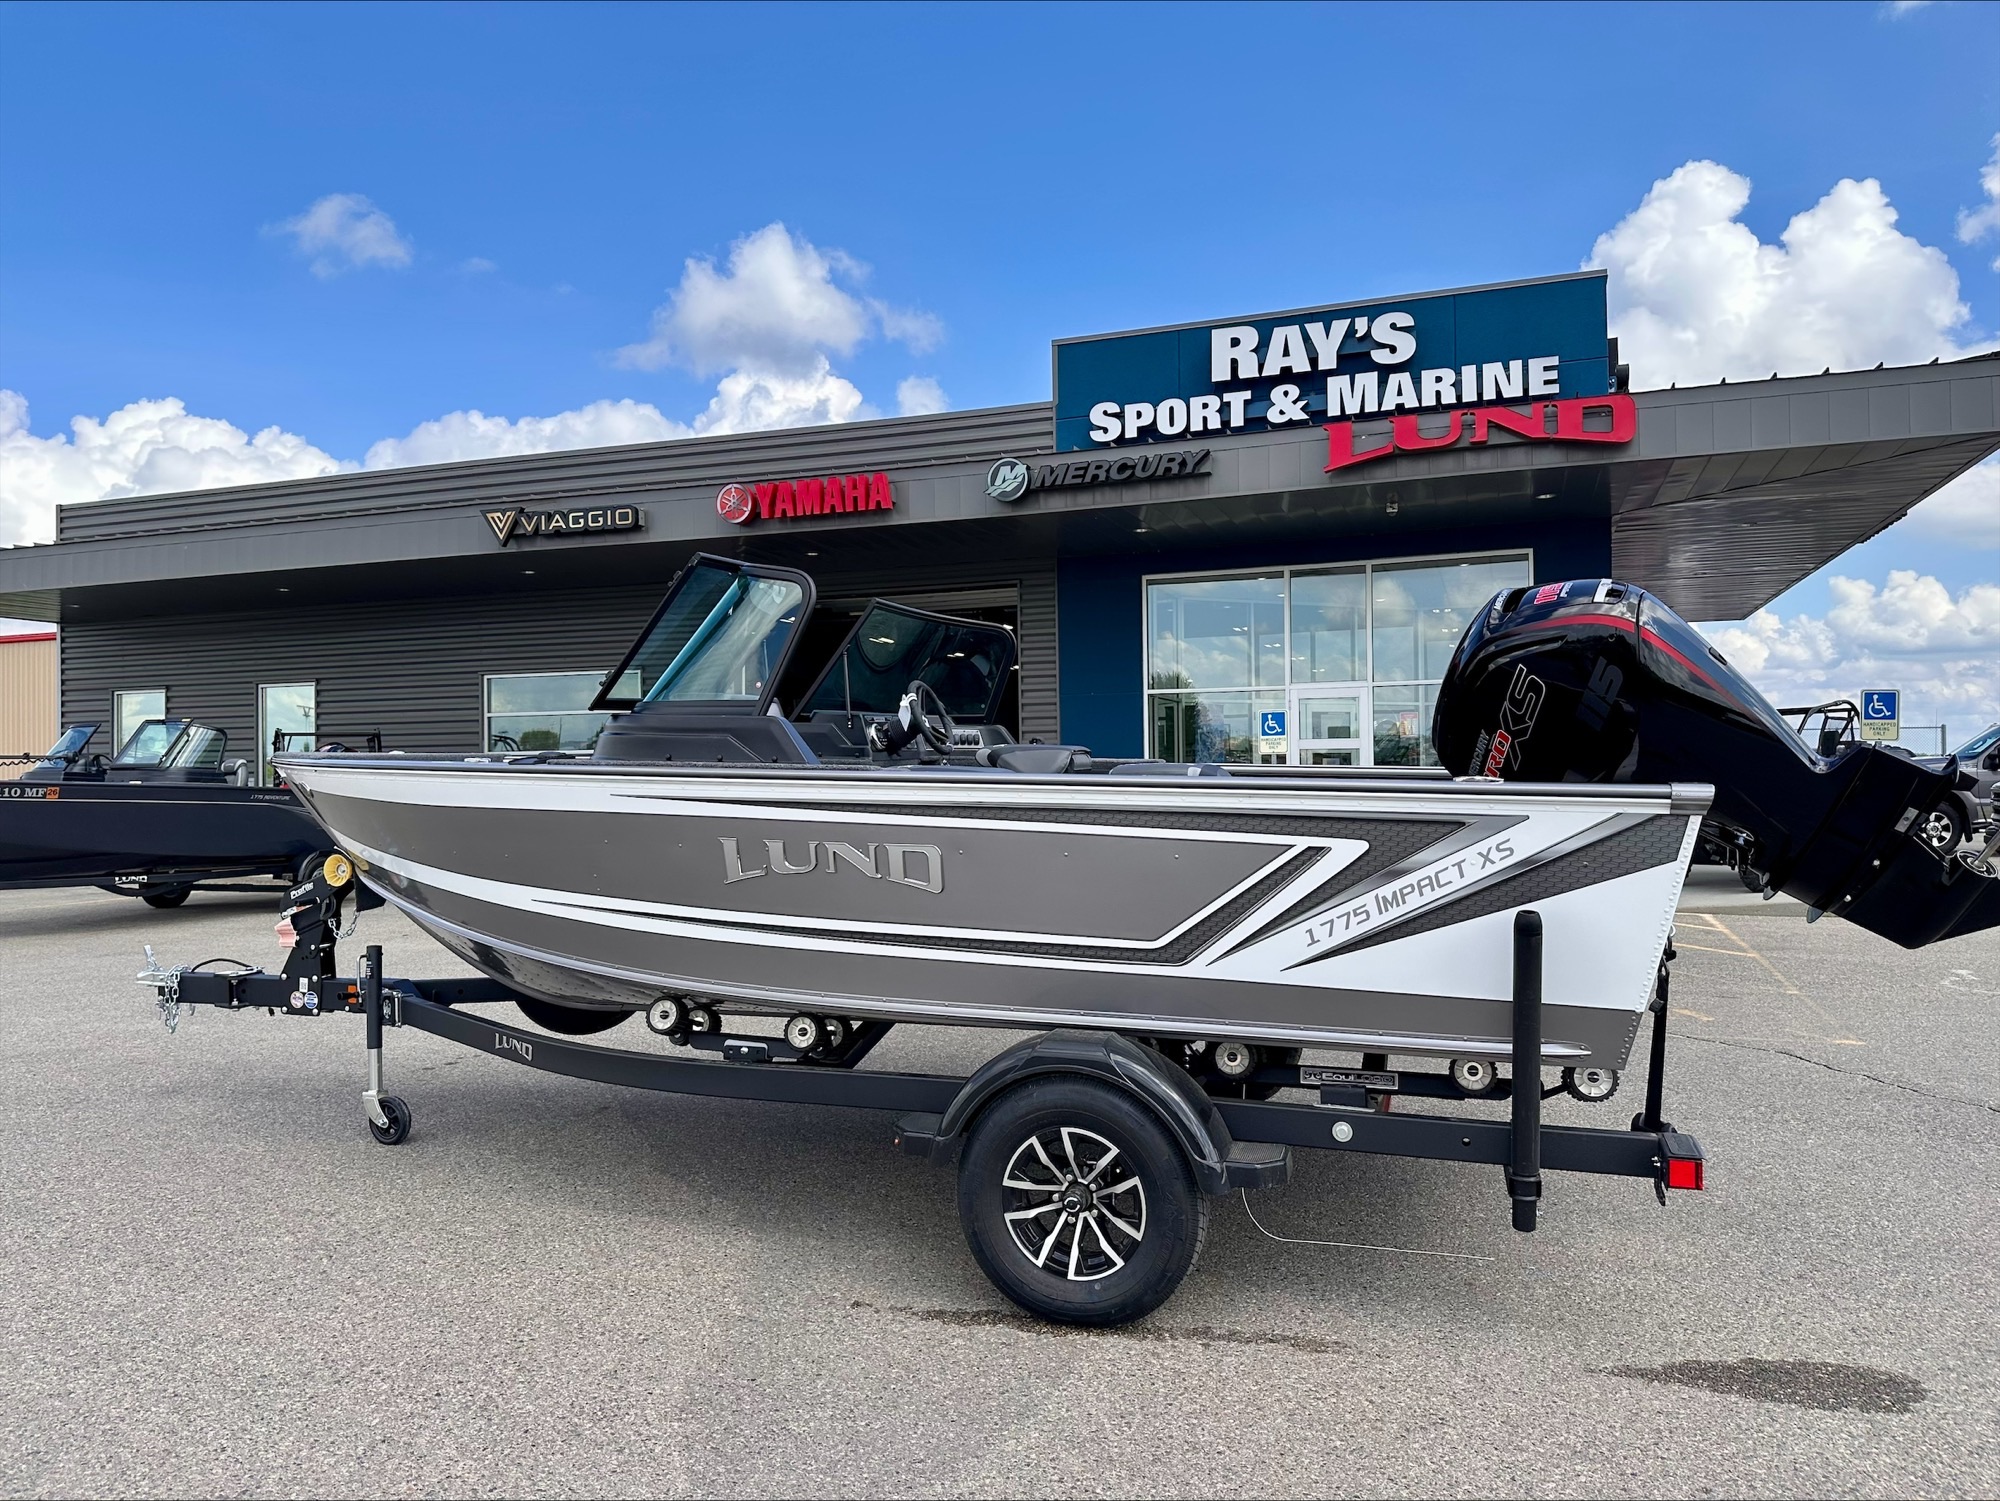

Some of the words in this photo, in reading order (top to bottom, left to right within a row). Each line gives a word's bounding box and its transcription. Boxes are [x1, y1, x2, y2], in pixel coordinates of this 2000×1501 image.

[1211, 311, 1418, 383] RAY'S
[1088, 390, 1252, 443] SPORT
[1266, 384, 1310, 423] &
[1327, 355, 1560, 418] MARINE
[1322, 395, 1637, 474] LUND
[1034, 449, 1211, 488] MERCURY
[754, 472, 894, 519] YAMAHA
[520, 508, 633, 532] VIAGGIO
[1469, 729, 1490, 777] ERCURY
[1483, 729, 1511, 778] RO
[0, 787, 21, 798] 10
[24, 787, 46, 798] MF
[47, 788, 58, 796] 26
[114, 875, 148, 885] LUND
[717, 836, 945, 894] LUND
[1305, 903, 1371, 948] 1775
[1374, 858, 1467, 916] IMPACT
[1476, 837, 1515, 870] XS
[494, 1032, 533, 1062] LUND
